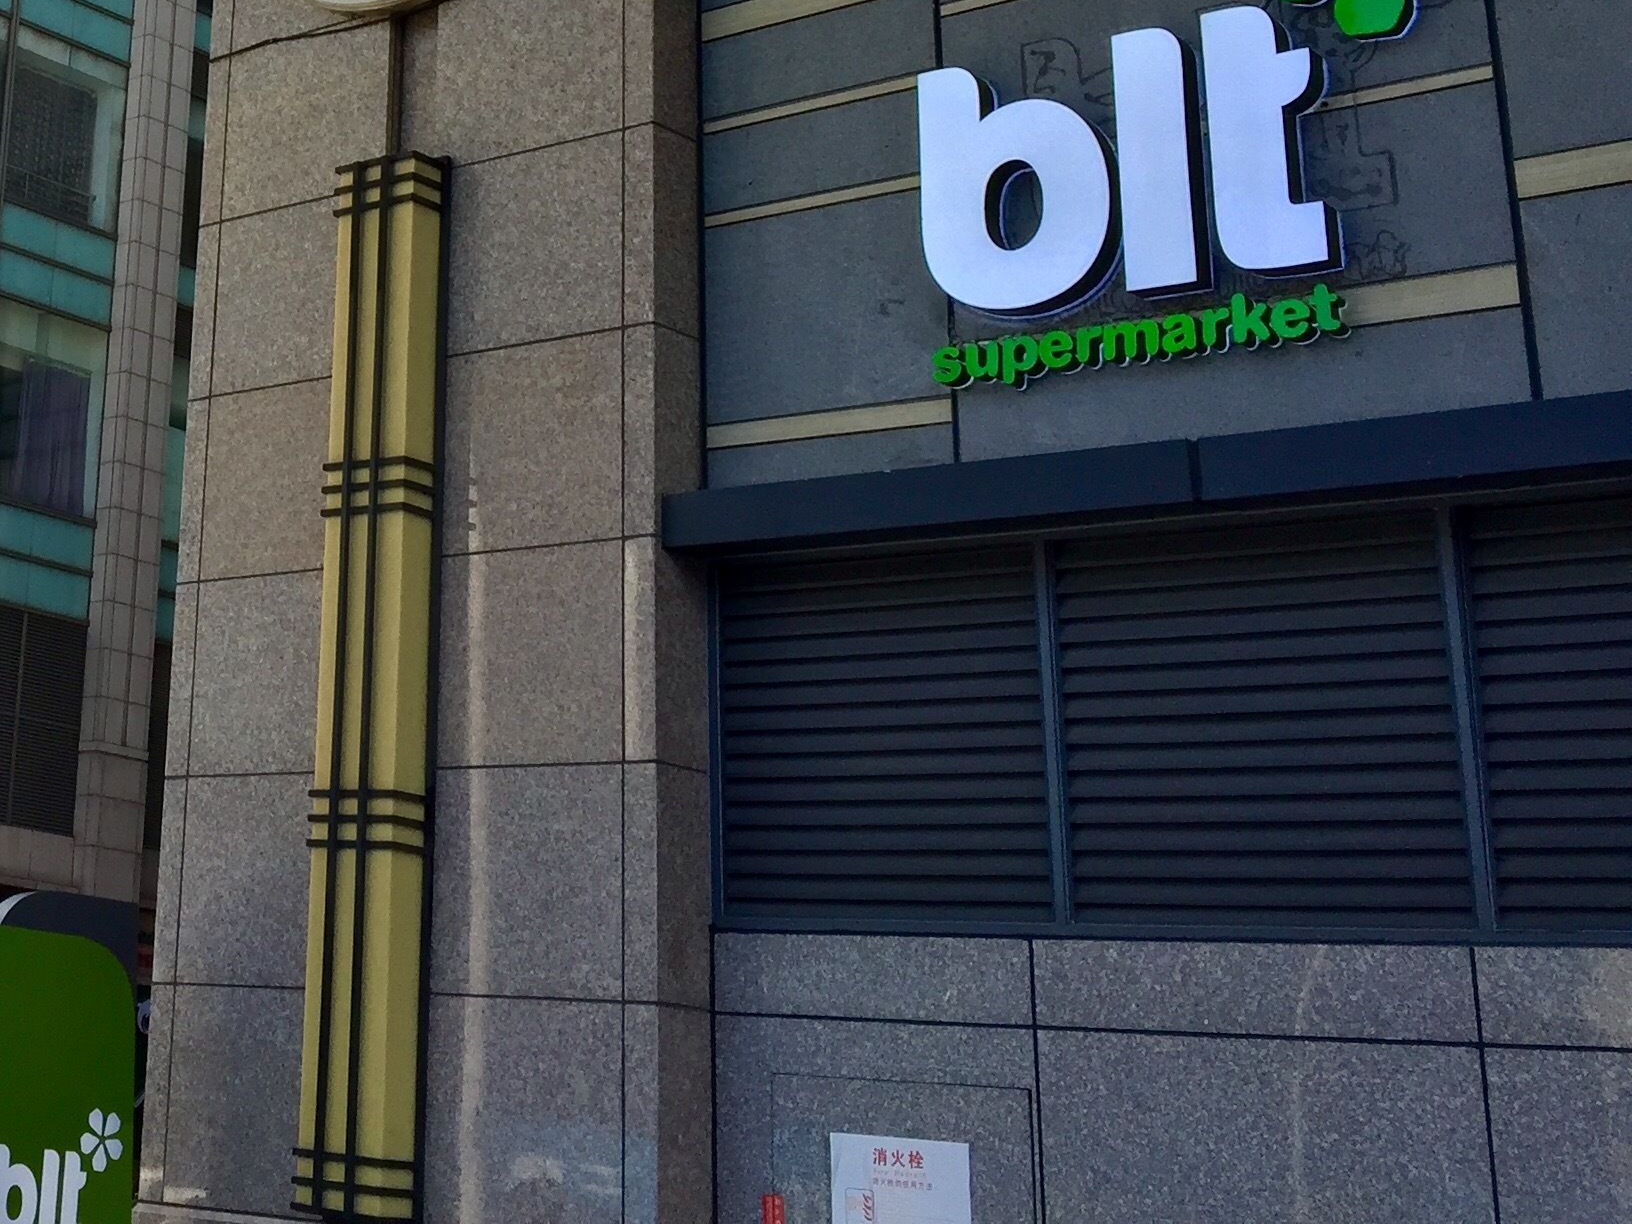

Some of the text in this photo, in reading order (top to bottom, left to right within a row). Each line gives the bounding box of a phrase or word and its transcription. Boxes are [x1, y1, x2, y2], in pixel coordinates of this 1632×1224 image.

[916, 5, 1342, 317] blt
[931, 283, 1349, 387] supermarket
[872, 1147, 925, 1170] 消火栓
